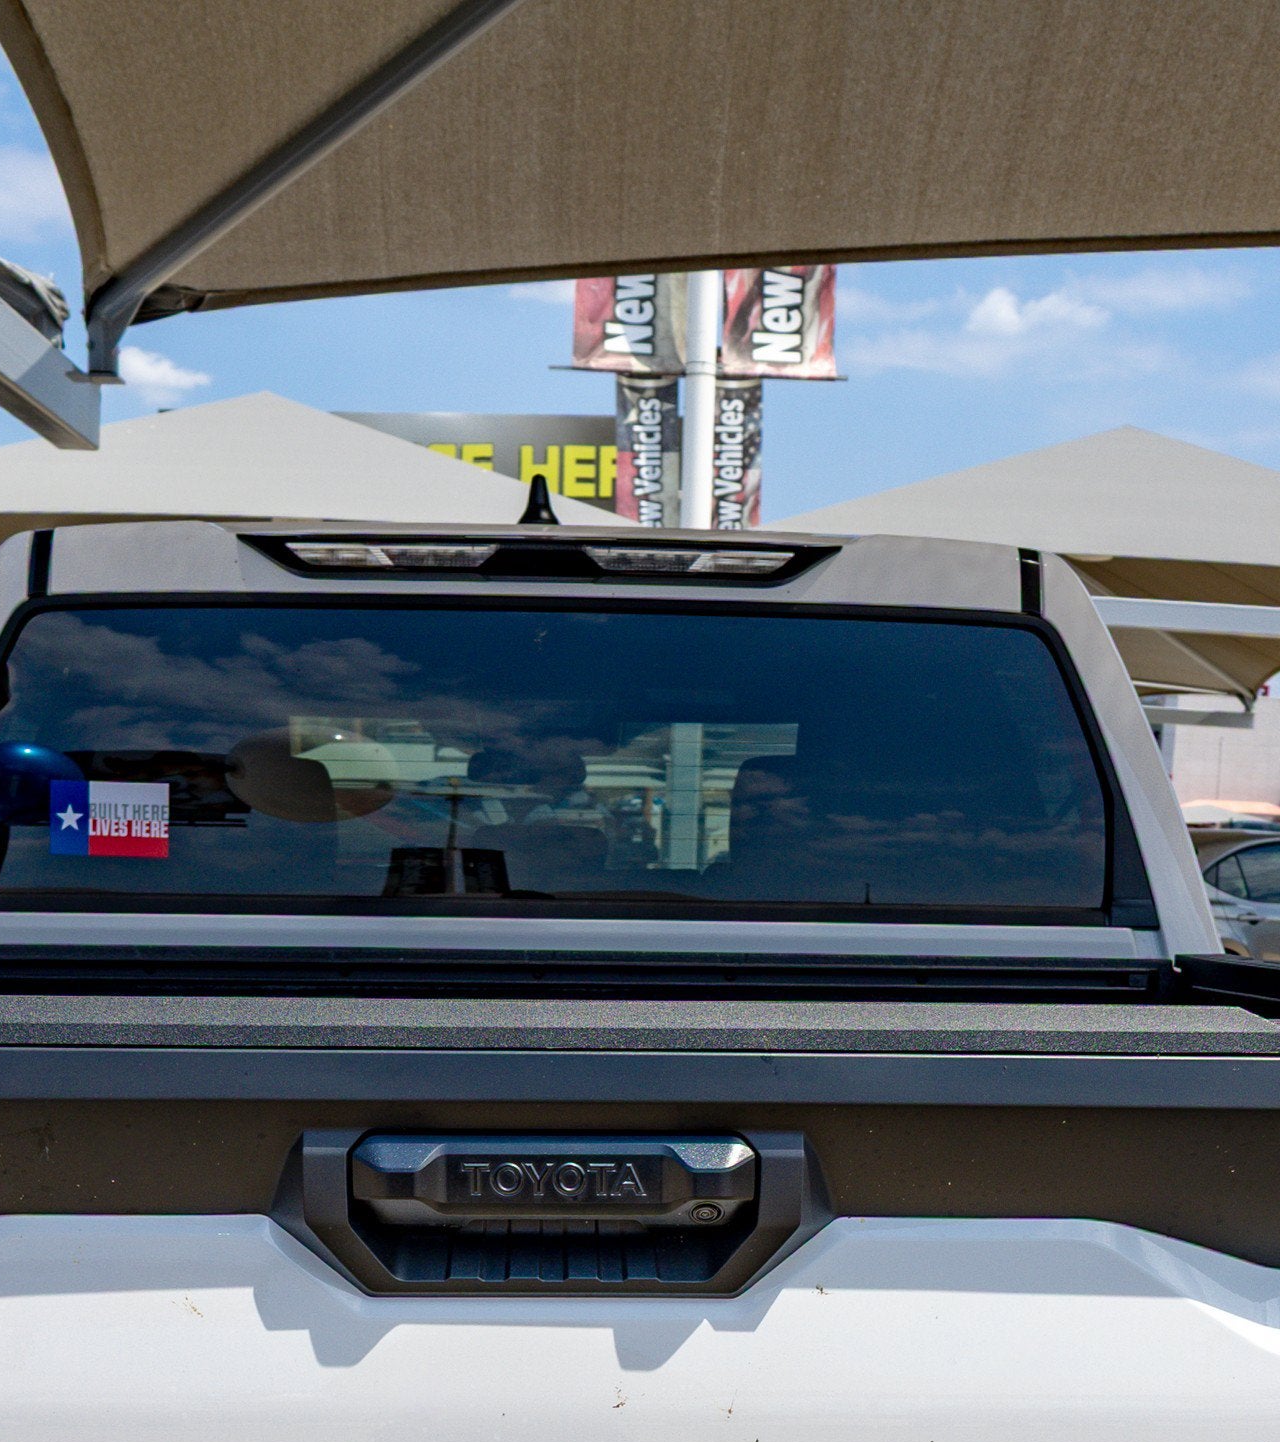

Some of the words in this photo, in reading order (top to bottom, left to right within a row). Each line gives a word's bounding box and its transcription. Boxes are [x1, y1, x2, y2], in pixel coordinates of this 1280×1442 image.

[752, 270, 804, 363] New
[632, 398, 662, 496] Vehicles
[713, 399, 745, 496] Vehicles
[89, 803, 129, 820] BUILT
[132, 804, 169, 820] HERE
[89, 818, 128, 837] LIVES
[131, 820, 169, 839] HERE
[460, 1162, 647, 1198] TOYOTA
